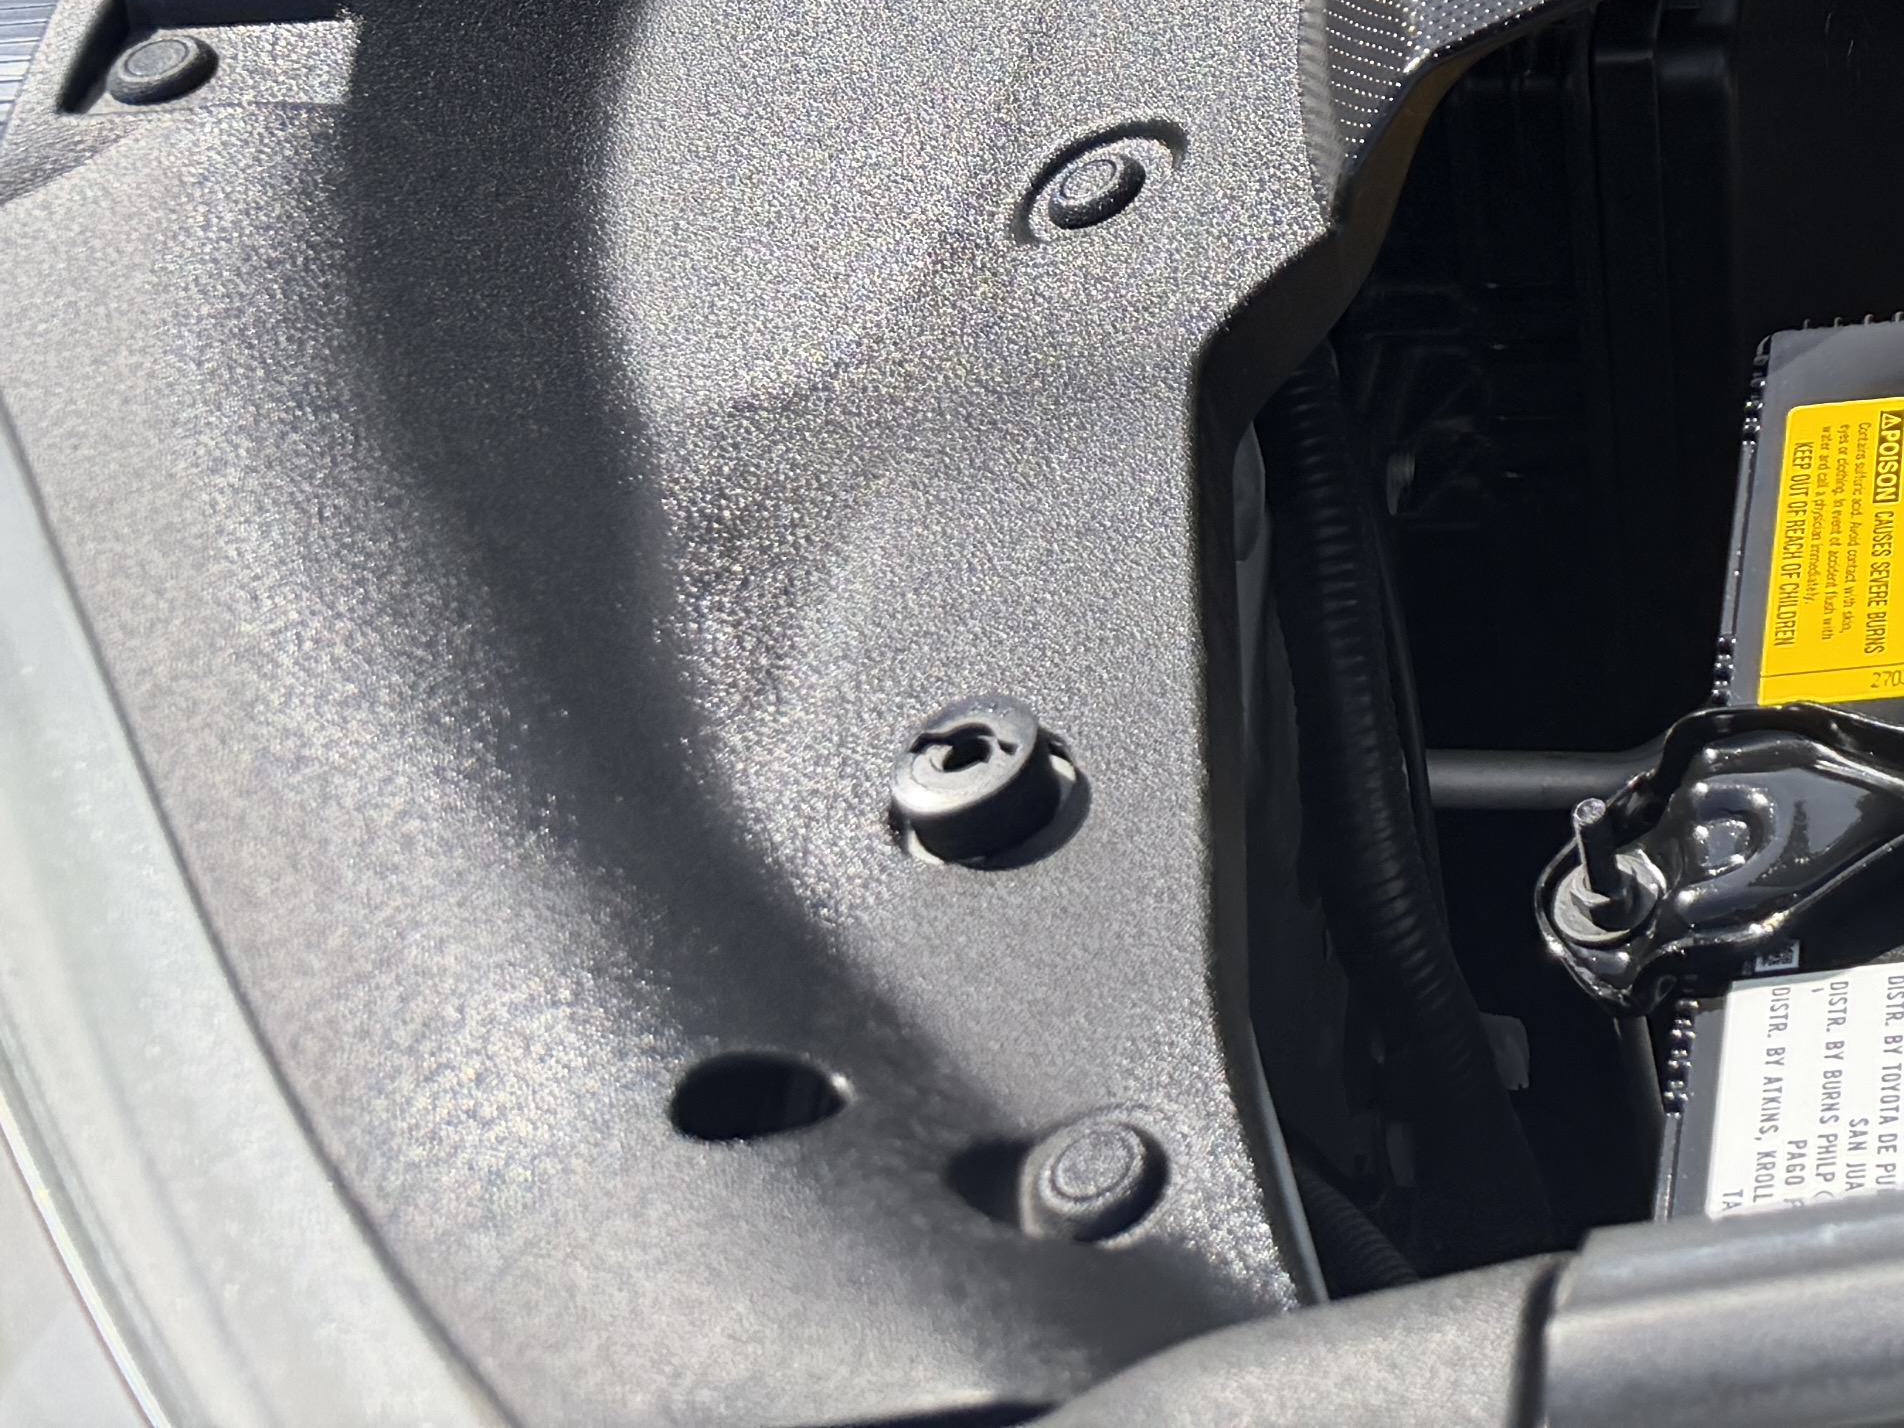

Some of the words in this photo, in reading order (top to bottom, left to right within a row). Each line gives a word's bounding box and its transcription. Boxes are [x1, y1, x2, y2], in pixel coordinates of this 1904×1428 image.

[1820, 426, 1833, 450] water
[1836, 424, 1850, 444] eyes
[1838, 446, 1848, 455] or
[1855, 421, 1870, 459] Contains
[1791, 441, 1813, 470] KEEP
[1818, 454, 1830, 470] and
[1875, 429, 1900, 501] POISON
[1789, 473, 1810, 497] OUT
[1816, 472, 1828, 487] call
[1831, 457, 1848, 495] clothing.
[1852, 461, 1867, 495] sulfuric
[1787, 500, 1807, 516] OF
[1833, 498, 1844, 507] In
[1850, 498, 1863, 518] acid.
[1808, 499, 1826, 541] physician
[1830, 509, 1843, 534] event
[1848, 521, 1861, 545] Avoid
[1871, 510, 1894, 557] CAUSES
[1782, 519, 1806, 560] REACH
[1829, 536, 1841, 546] of
[1780, 563, 1801, 579] OF
[1802, 543, 1821, 604] immediately.
[1825, 549, 1840, 588] accident
[1844, 549, 1859, 583] contact
[1842, 585, 1856, 607] with
[1867, 561, 1890, 607] SEVERE
[1773, 582, 1799, 646] CHILDREN
[1823, 591, 1837, 614] flush
[1820, 617, 1834, 639] with
[1838, 610, 1854, 633] skin,
[1863, 611, 1887, 654] BURNS
[1766, 986, 1791, 1038] DISTR.
[1825, 980, 1848, 1032] DISTR.
[1763, 1046, 1785, 1068] BY
[1823, 1039, 1844, 1061] BY
[1882, 1034, 1903, 1056] BY
[1753, 1074, 1782, 1141] ATKINS,
[1818, 1068, 1842, 1125] BURNS
[1878, 1063, 1901, 1125] TOYOTA
[1846, 1116, 1869, 1152] SAN
[1876, 1131, 1897, 1155] DE
[1783, 1138, 1807, 1186] PAGO
[1813, 1132, 1837, 1184] PHILP
[1751, 1149, 1776, 1203] KROLL
[1873, 1161, 1895, 1194] PU
